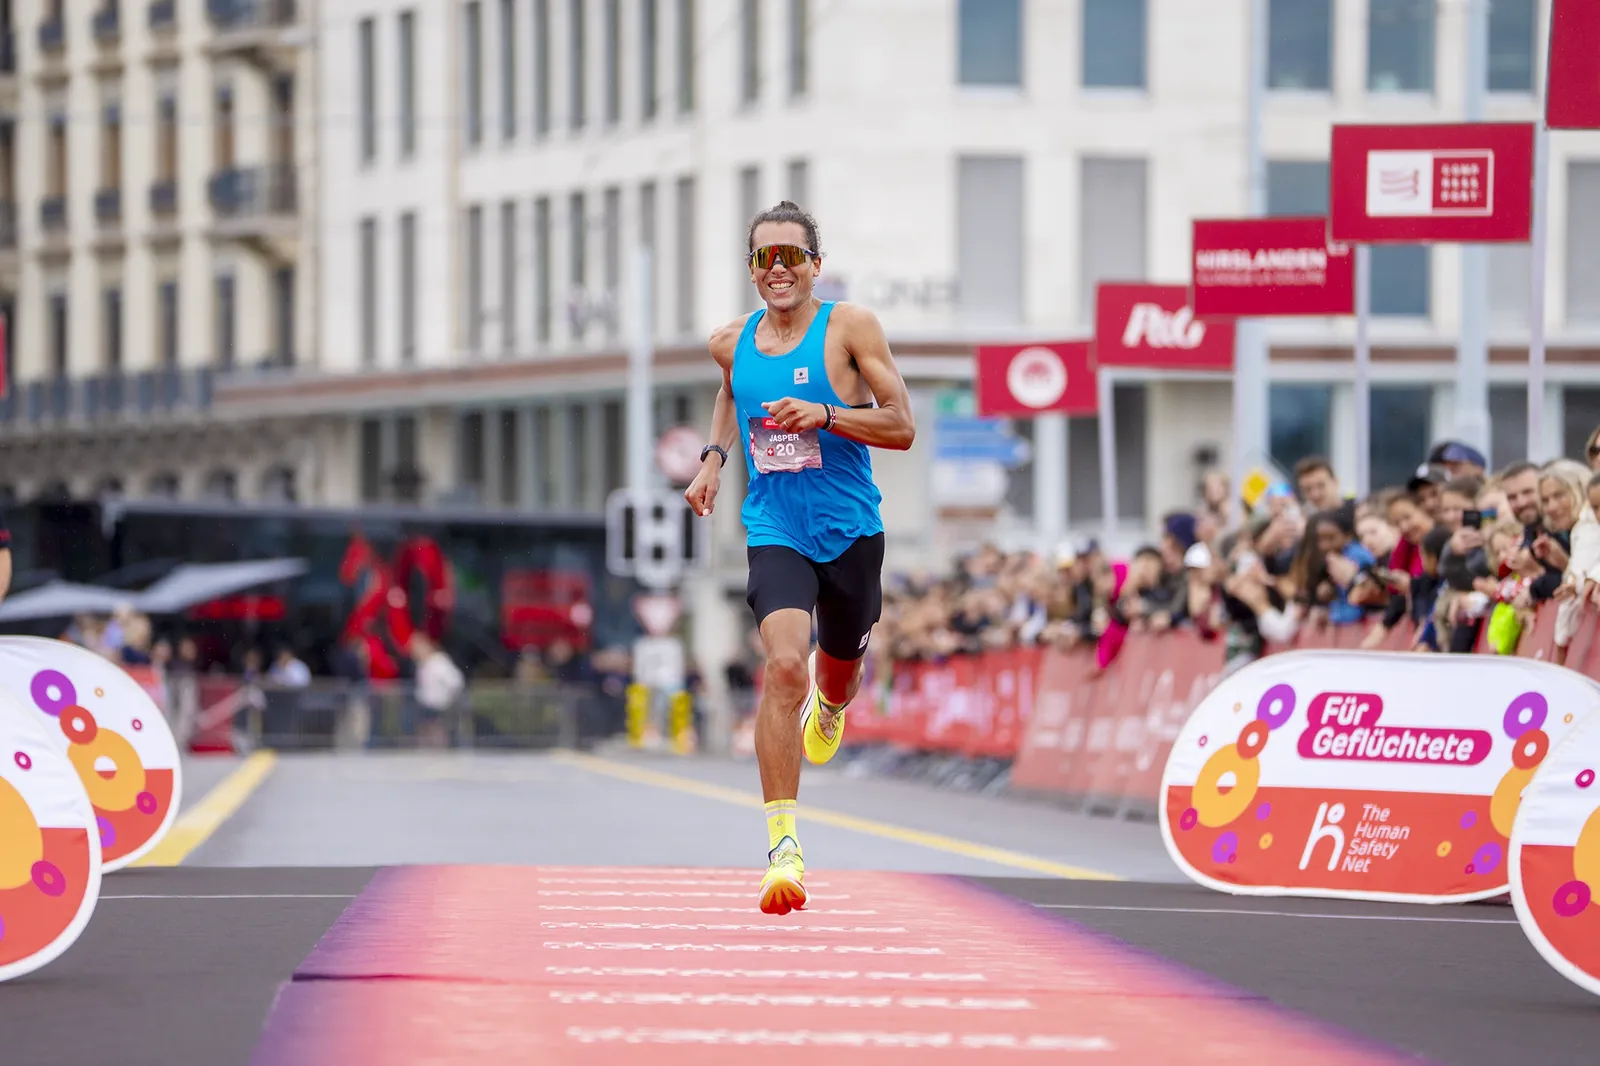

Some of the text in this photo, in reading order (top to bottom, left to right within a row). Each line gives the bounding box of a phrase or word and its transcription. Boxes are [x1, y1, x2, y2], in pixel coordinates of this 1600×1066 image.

[1196, 248, 1327, 270] HIRSLANDEN
[769, 433, 799, 442] JASPER
[776, 443, 795, 456] 20
[1320, 696, 1370, 726] Für
[1312, 727, 1475, 762] Geflüchtete
[1361, 803, 1391, 822] The
[1353, 821, 1411, 840] Human
[1347, 838, 1400, 860] Safety
[1341, 856, 1372, 873] Net
